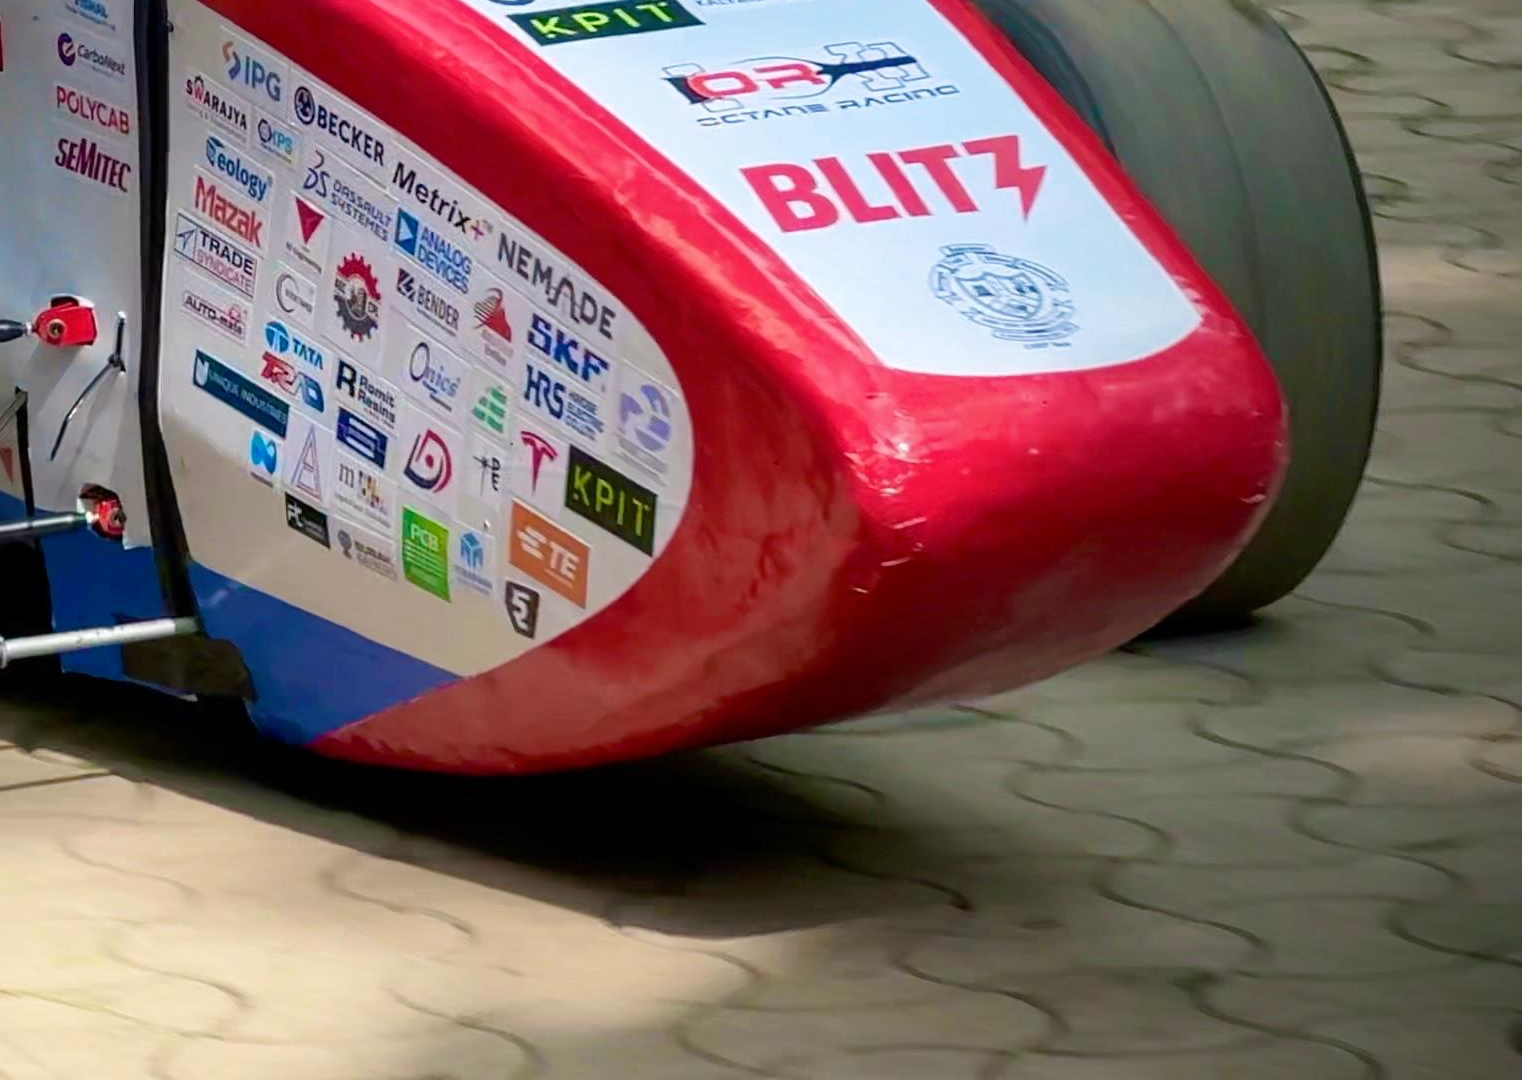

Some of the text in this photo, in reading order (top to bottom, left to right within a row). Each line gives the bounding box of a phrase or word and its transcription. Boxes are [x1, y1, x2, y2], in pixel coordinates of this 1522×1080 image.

[529, 0, 674, 39] KPIT
[186, 77, 247, 130] SWARAJYA
[245, 56, 281, 102] IPG
[56, 85, 130, 134] POLYCAB
[317, 105, 385, 166] BECKER
[55, 138, 132, 193] SEMITEC
[740, 134, 1048, 233] BLITZ
[194, 176, 264, 249] Mazak
[333, 180, 393, 228] DASSAULT
[196, 250, 254, 294] SYNDICATE
[199, 231, 255, 276] TRADE
[417, 245, 469, 294] DEVICES
[421, 226, 473, 275] ANALOG
[417, 282, 460, 330] BENDER
[497, 232, 616, 339] NEMADE
[292, 338, 323, 370] TATA
[528, 313, 609, 381] SKF
[358, 389, 396, 423] Resins
[359, 375, 395, 408] Romit
[524, 364, 566, 420] HRS
[573, 465, 651, 537] KPIT
[410, 524, 439, 552] PCB
[549, 540, 579, 581] TE
